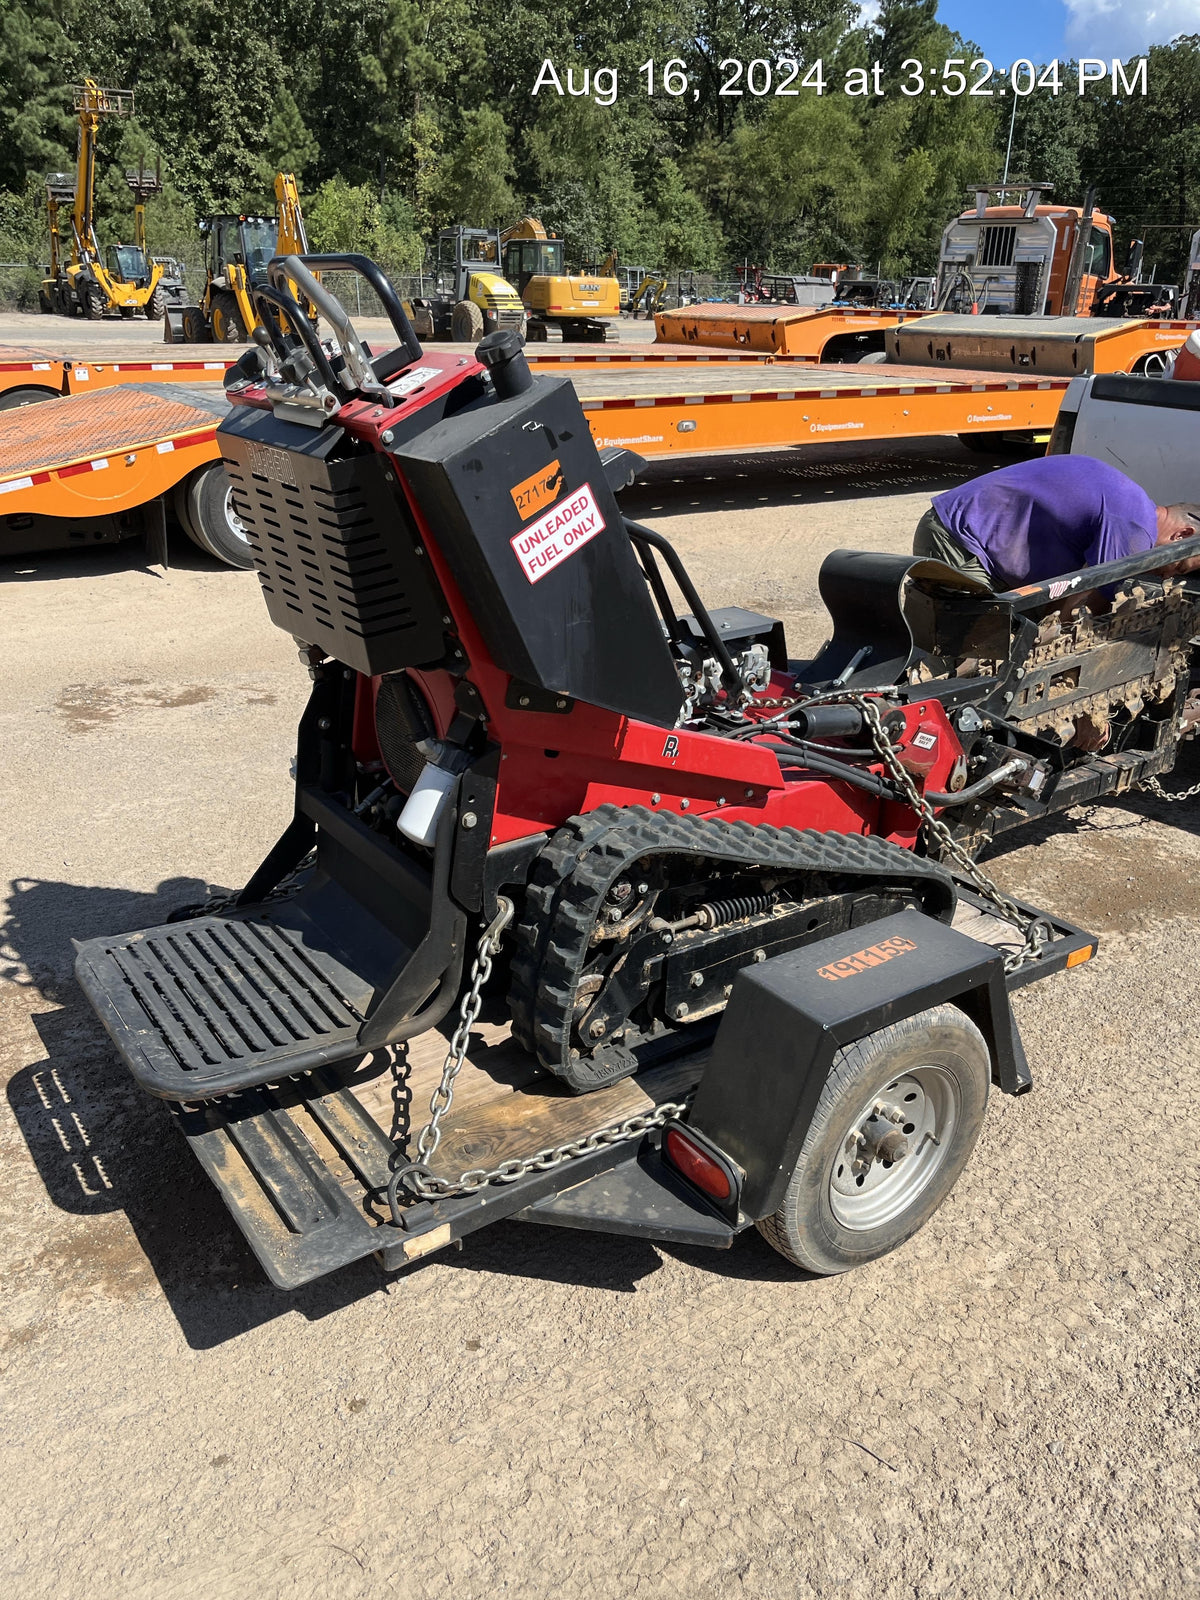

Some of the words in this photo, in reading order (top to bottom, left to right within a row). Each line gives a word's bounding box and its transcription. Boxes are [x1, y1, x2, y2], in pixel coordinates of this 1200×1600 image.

[816, 422, 864, 432] EquipmentShare
[973, 414, 1012, 422] EquipmentShare
[603, 435, 663, 446] EquipmentShare
[519, 496, 588, 554] UNLEADED
[528, 543, 563, 573] FUEL
[563, 513, 595, 546] ONLY
[822, 938, 916, 978] 191159
